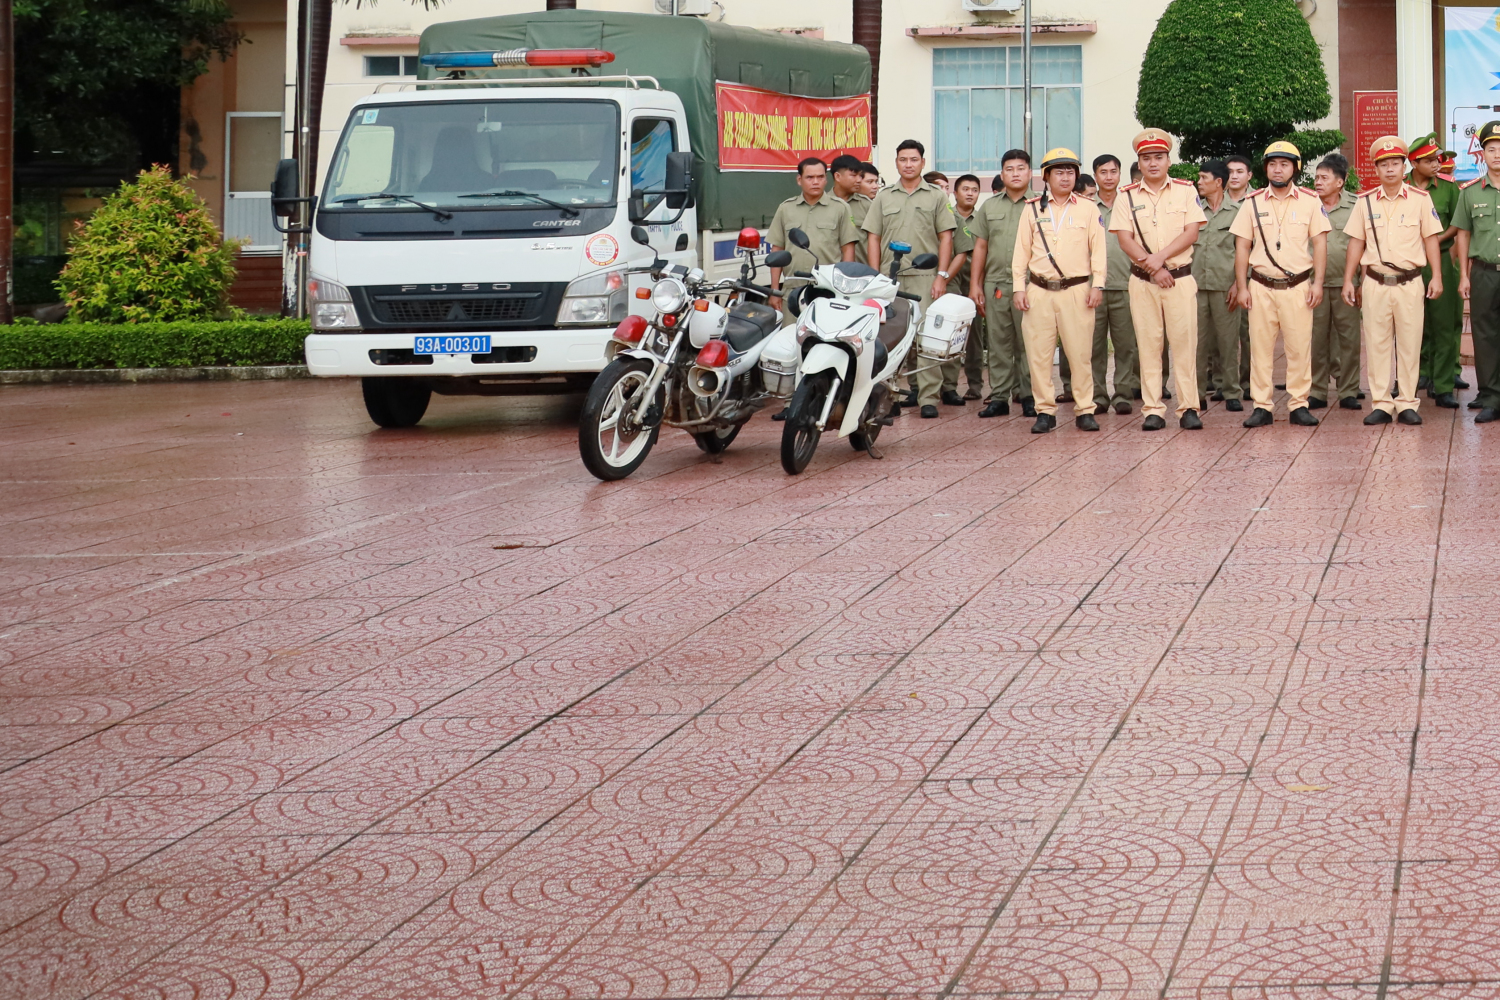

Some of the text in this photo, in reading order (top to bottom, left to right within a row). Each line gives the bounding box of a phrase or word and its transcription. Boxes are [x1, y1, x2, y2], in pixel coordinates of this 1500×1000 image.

[1465, 125, 1476, 135] 66
[532, 219, 582, 227] CANTER
[401, 283, 511, 292] FUSO
[416, 337, 487, 352] 93A-003.01
